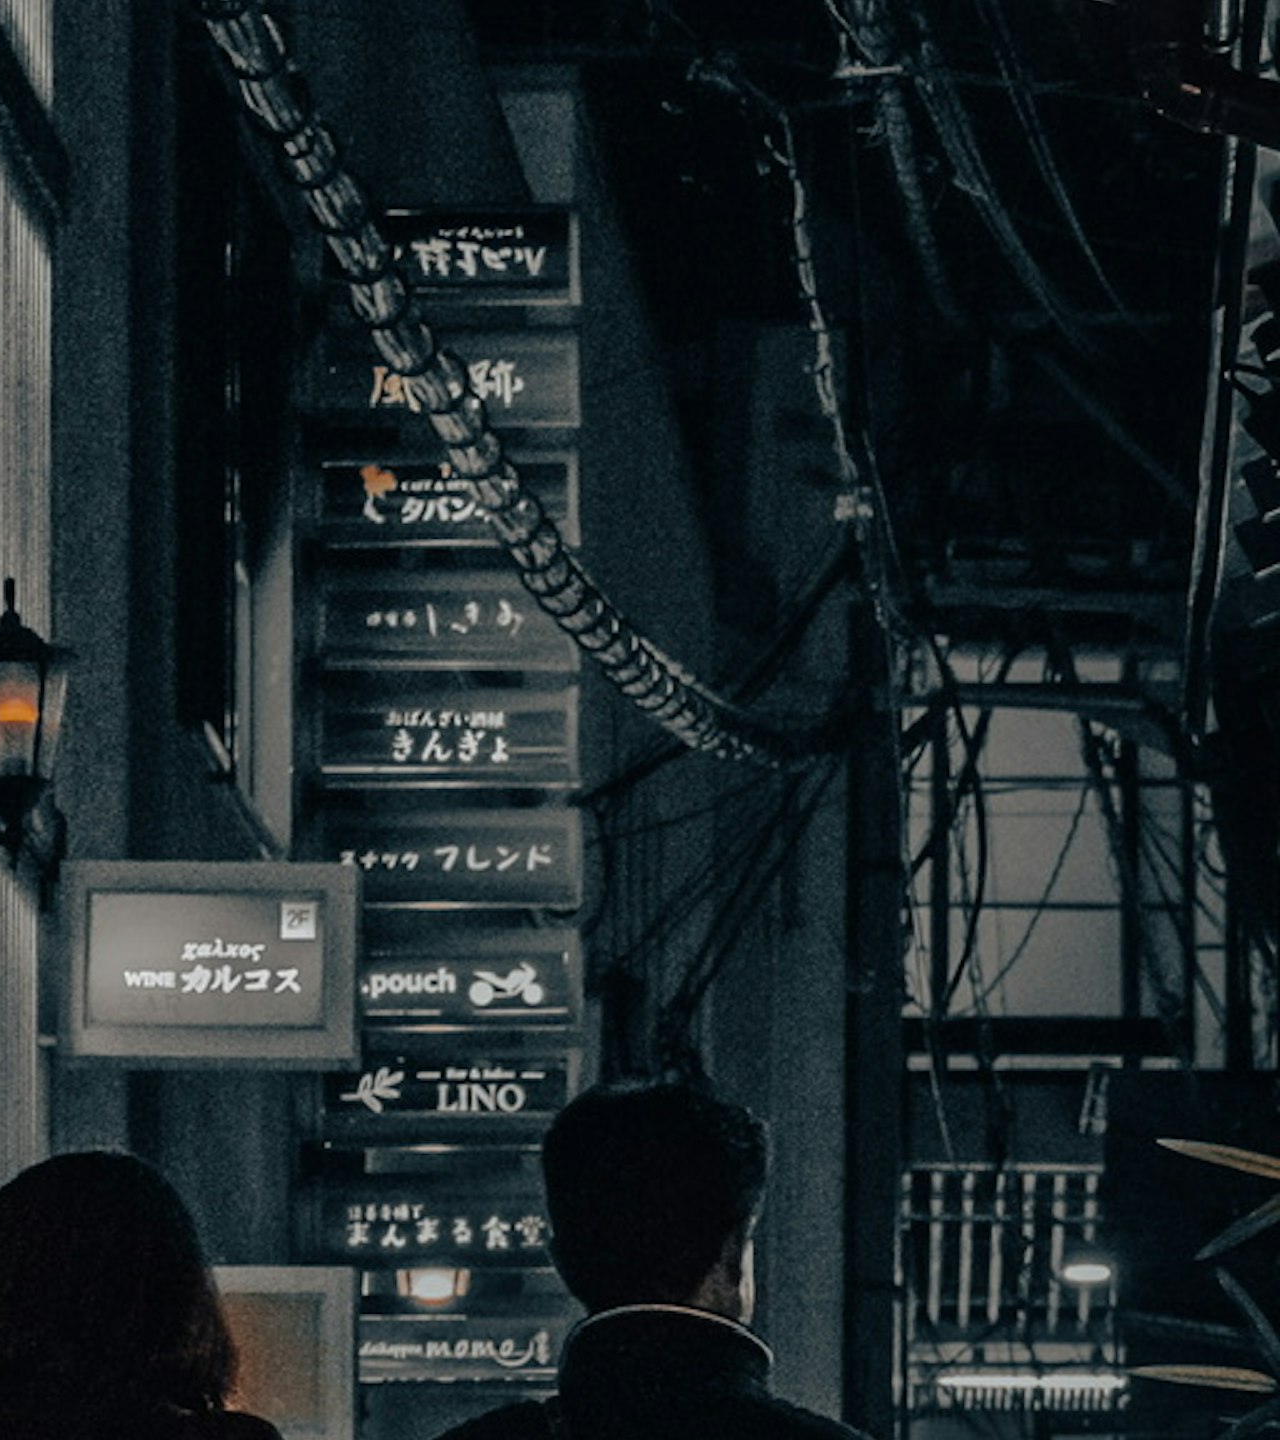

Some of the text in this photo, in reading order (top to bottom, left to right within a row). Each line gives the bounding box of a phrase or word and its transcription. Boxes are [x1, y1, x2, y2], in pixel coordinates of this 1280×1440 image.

[391, 729, 509, 763] きんぎょ
[340, 845, 552, 871] スナック フレンド
[287, 910, 310, 928] 2F
[124, 966, 301, 994] WINE カルコス
[438, 1083, 527, 1112] LINO
[346, 1216, 546, 1250] まんまる食堂
